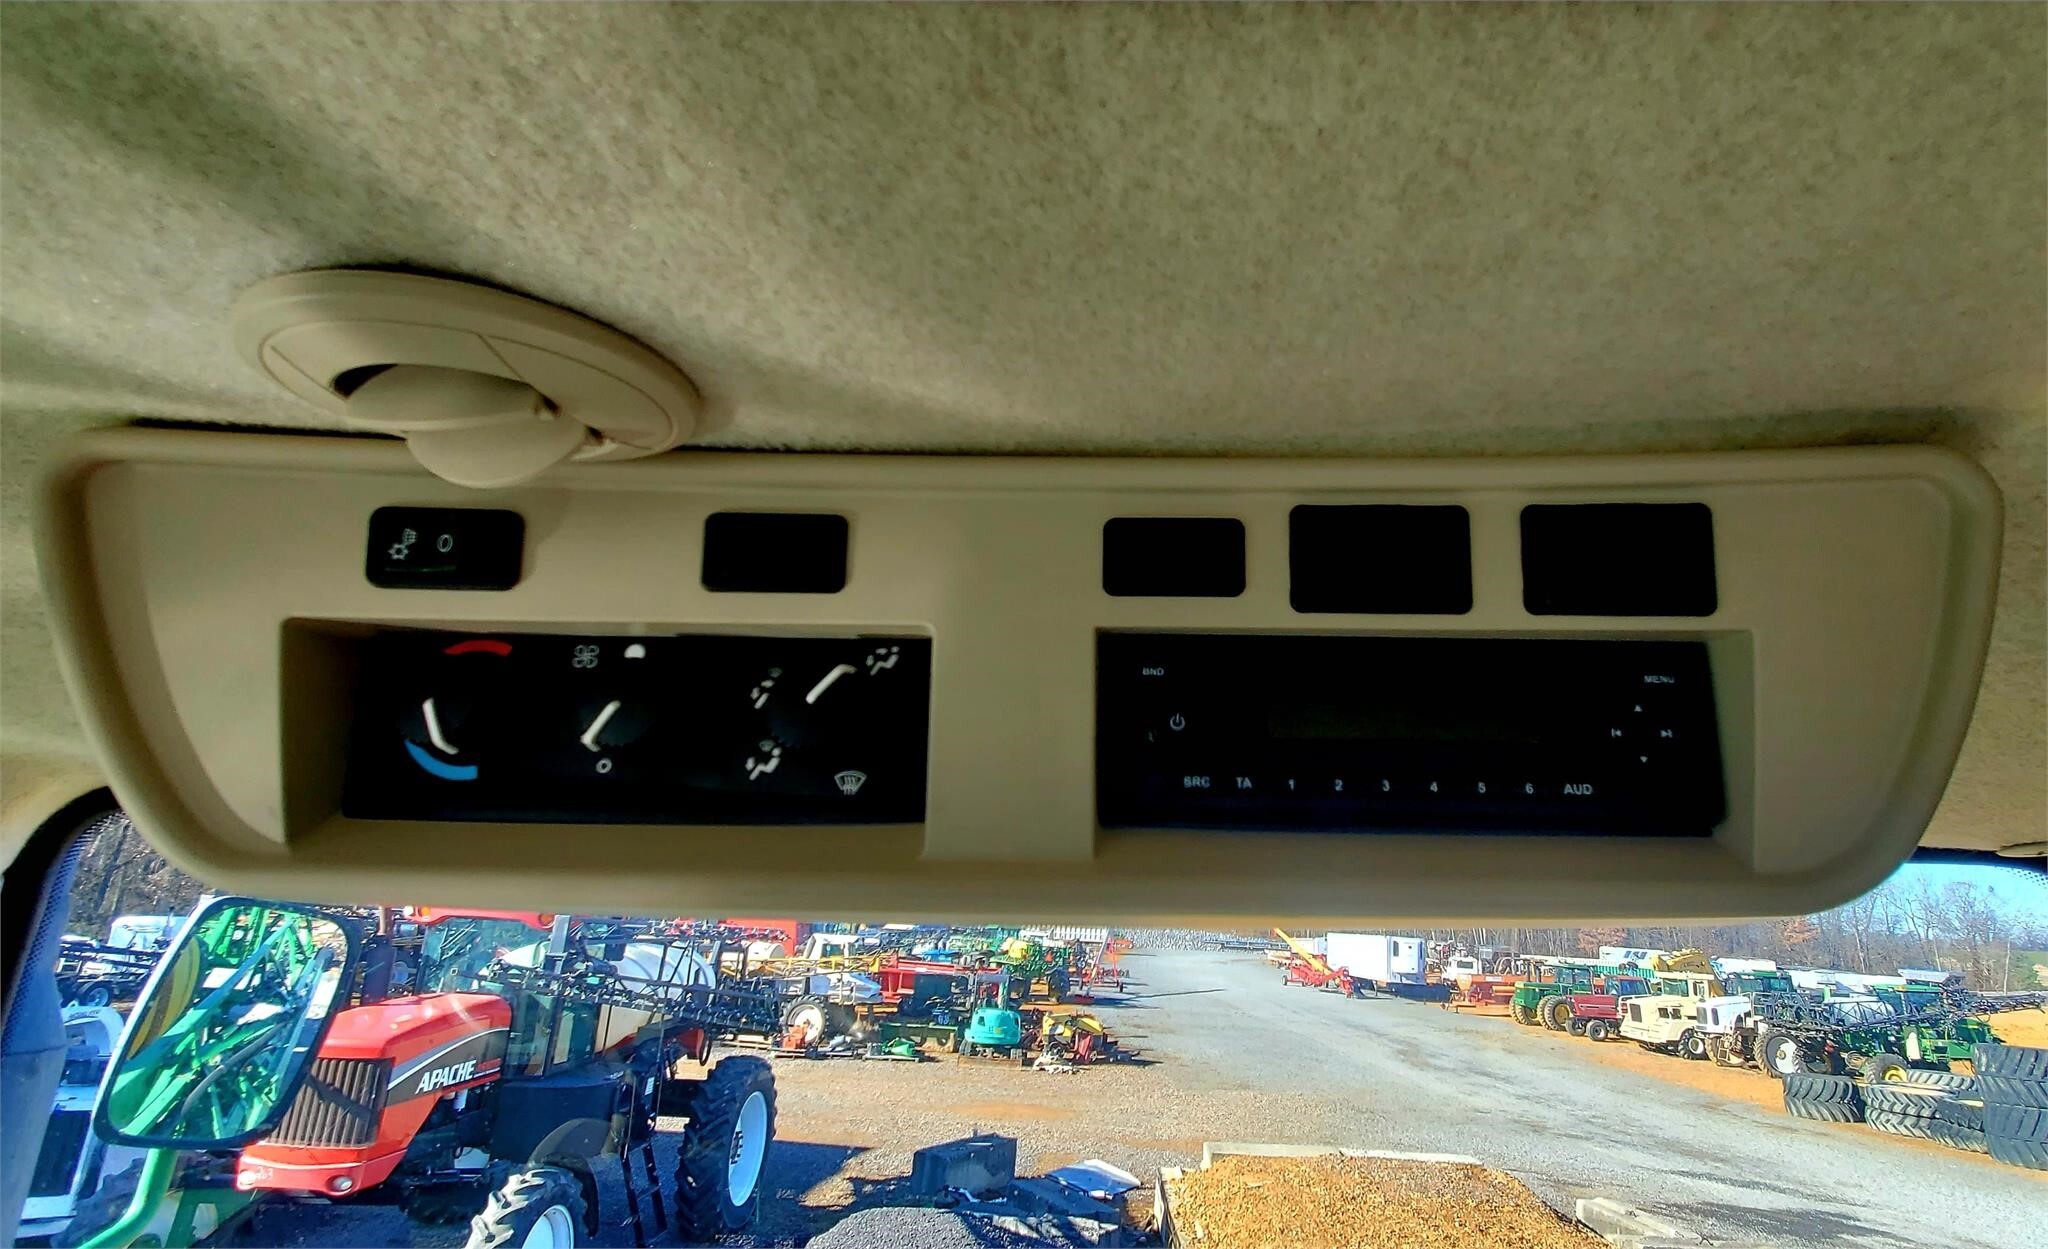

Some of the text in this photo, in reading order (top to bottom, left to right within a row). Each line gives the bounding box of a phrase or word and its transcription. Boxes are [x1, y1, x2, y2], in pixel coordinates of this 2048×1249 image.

[1643, 675, 1676, 684] MENU
[1183, 775, 1593, 796] SRC TA 1 2 3 4 5 6 AUD
[414, 1059, 477, 1095] APACHE
